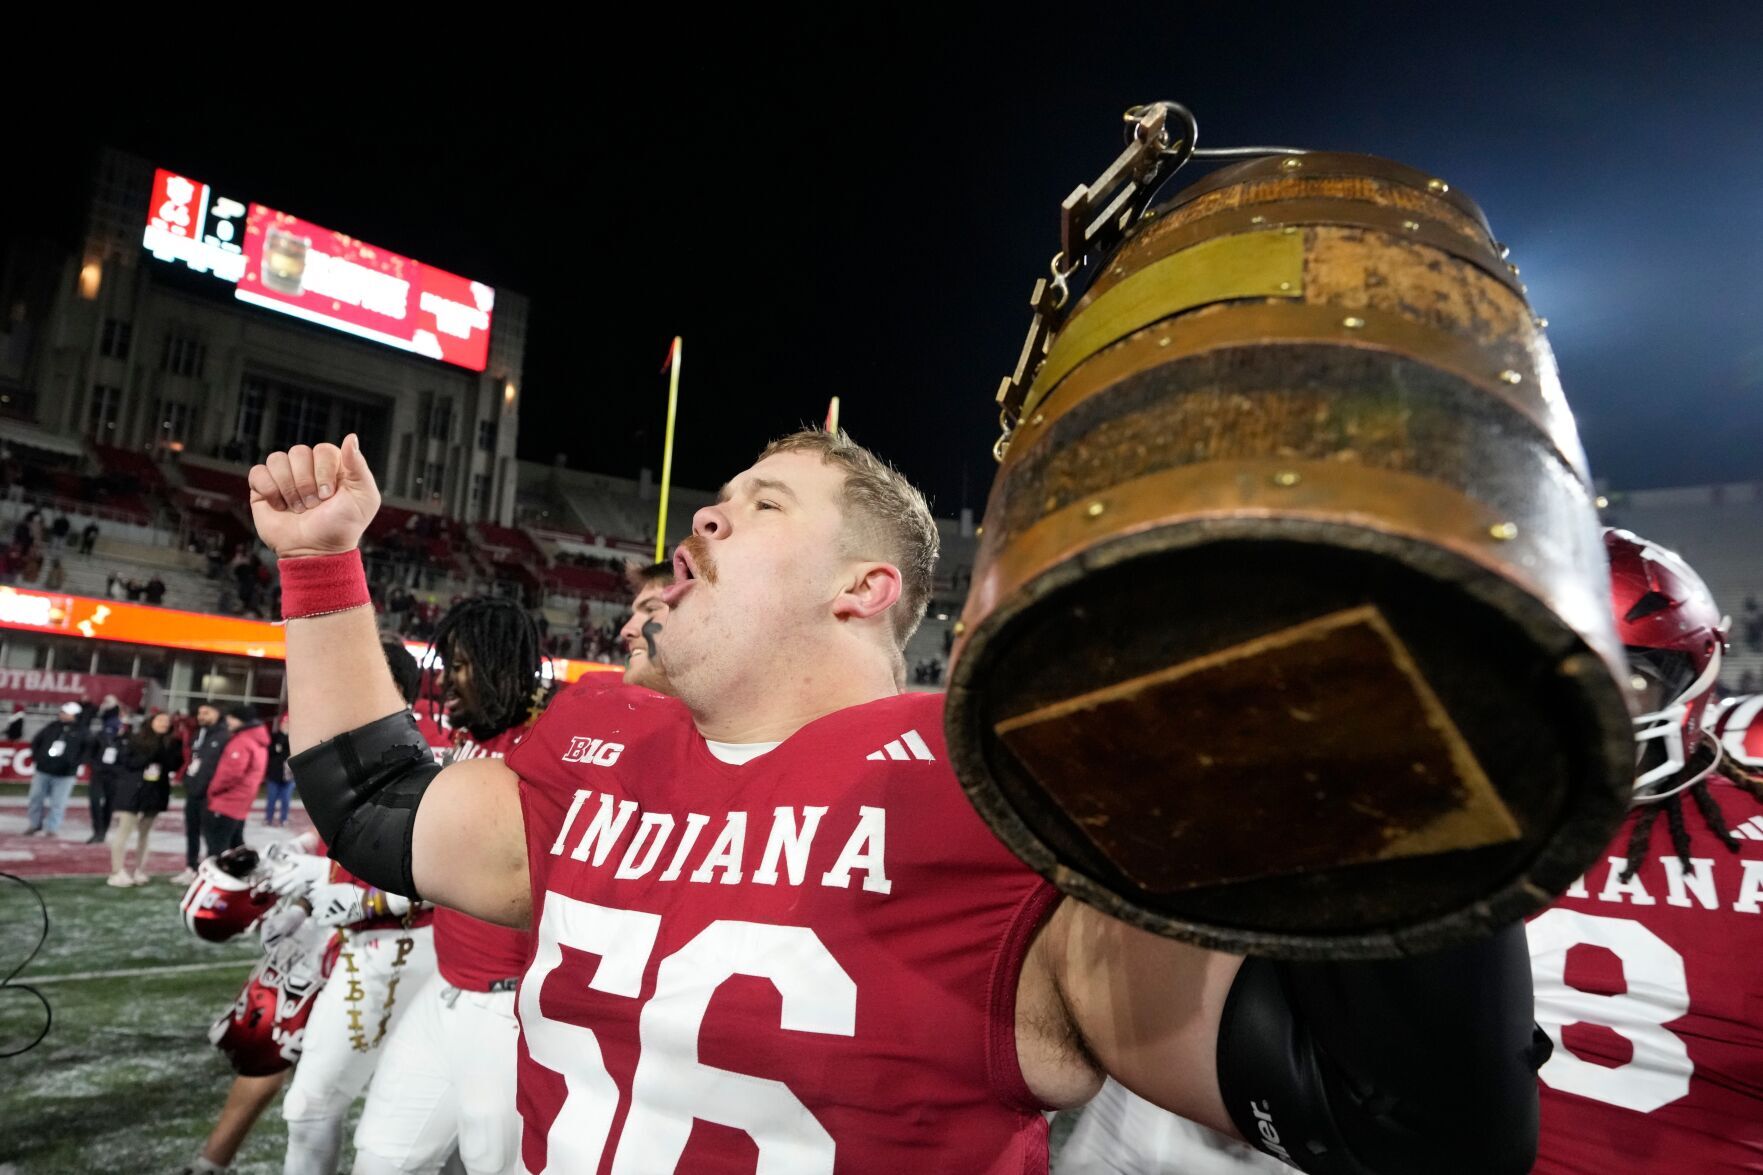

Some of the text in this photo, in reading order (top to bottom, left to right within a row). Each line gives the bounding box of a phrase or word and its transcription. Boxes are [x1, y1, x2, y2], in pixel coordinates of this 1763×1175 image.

[550, 789, 892, 895] INDIANA
[518, 890, 858, 1175] 56
[1525, 908, 1694, 1114] 8
